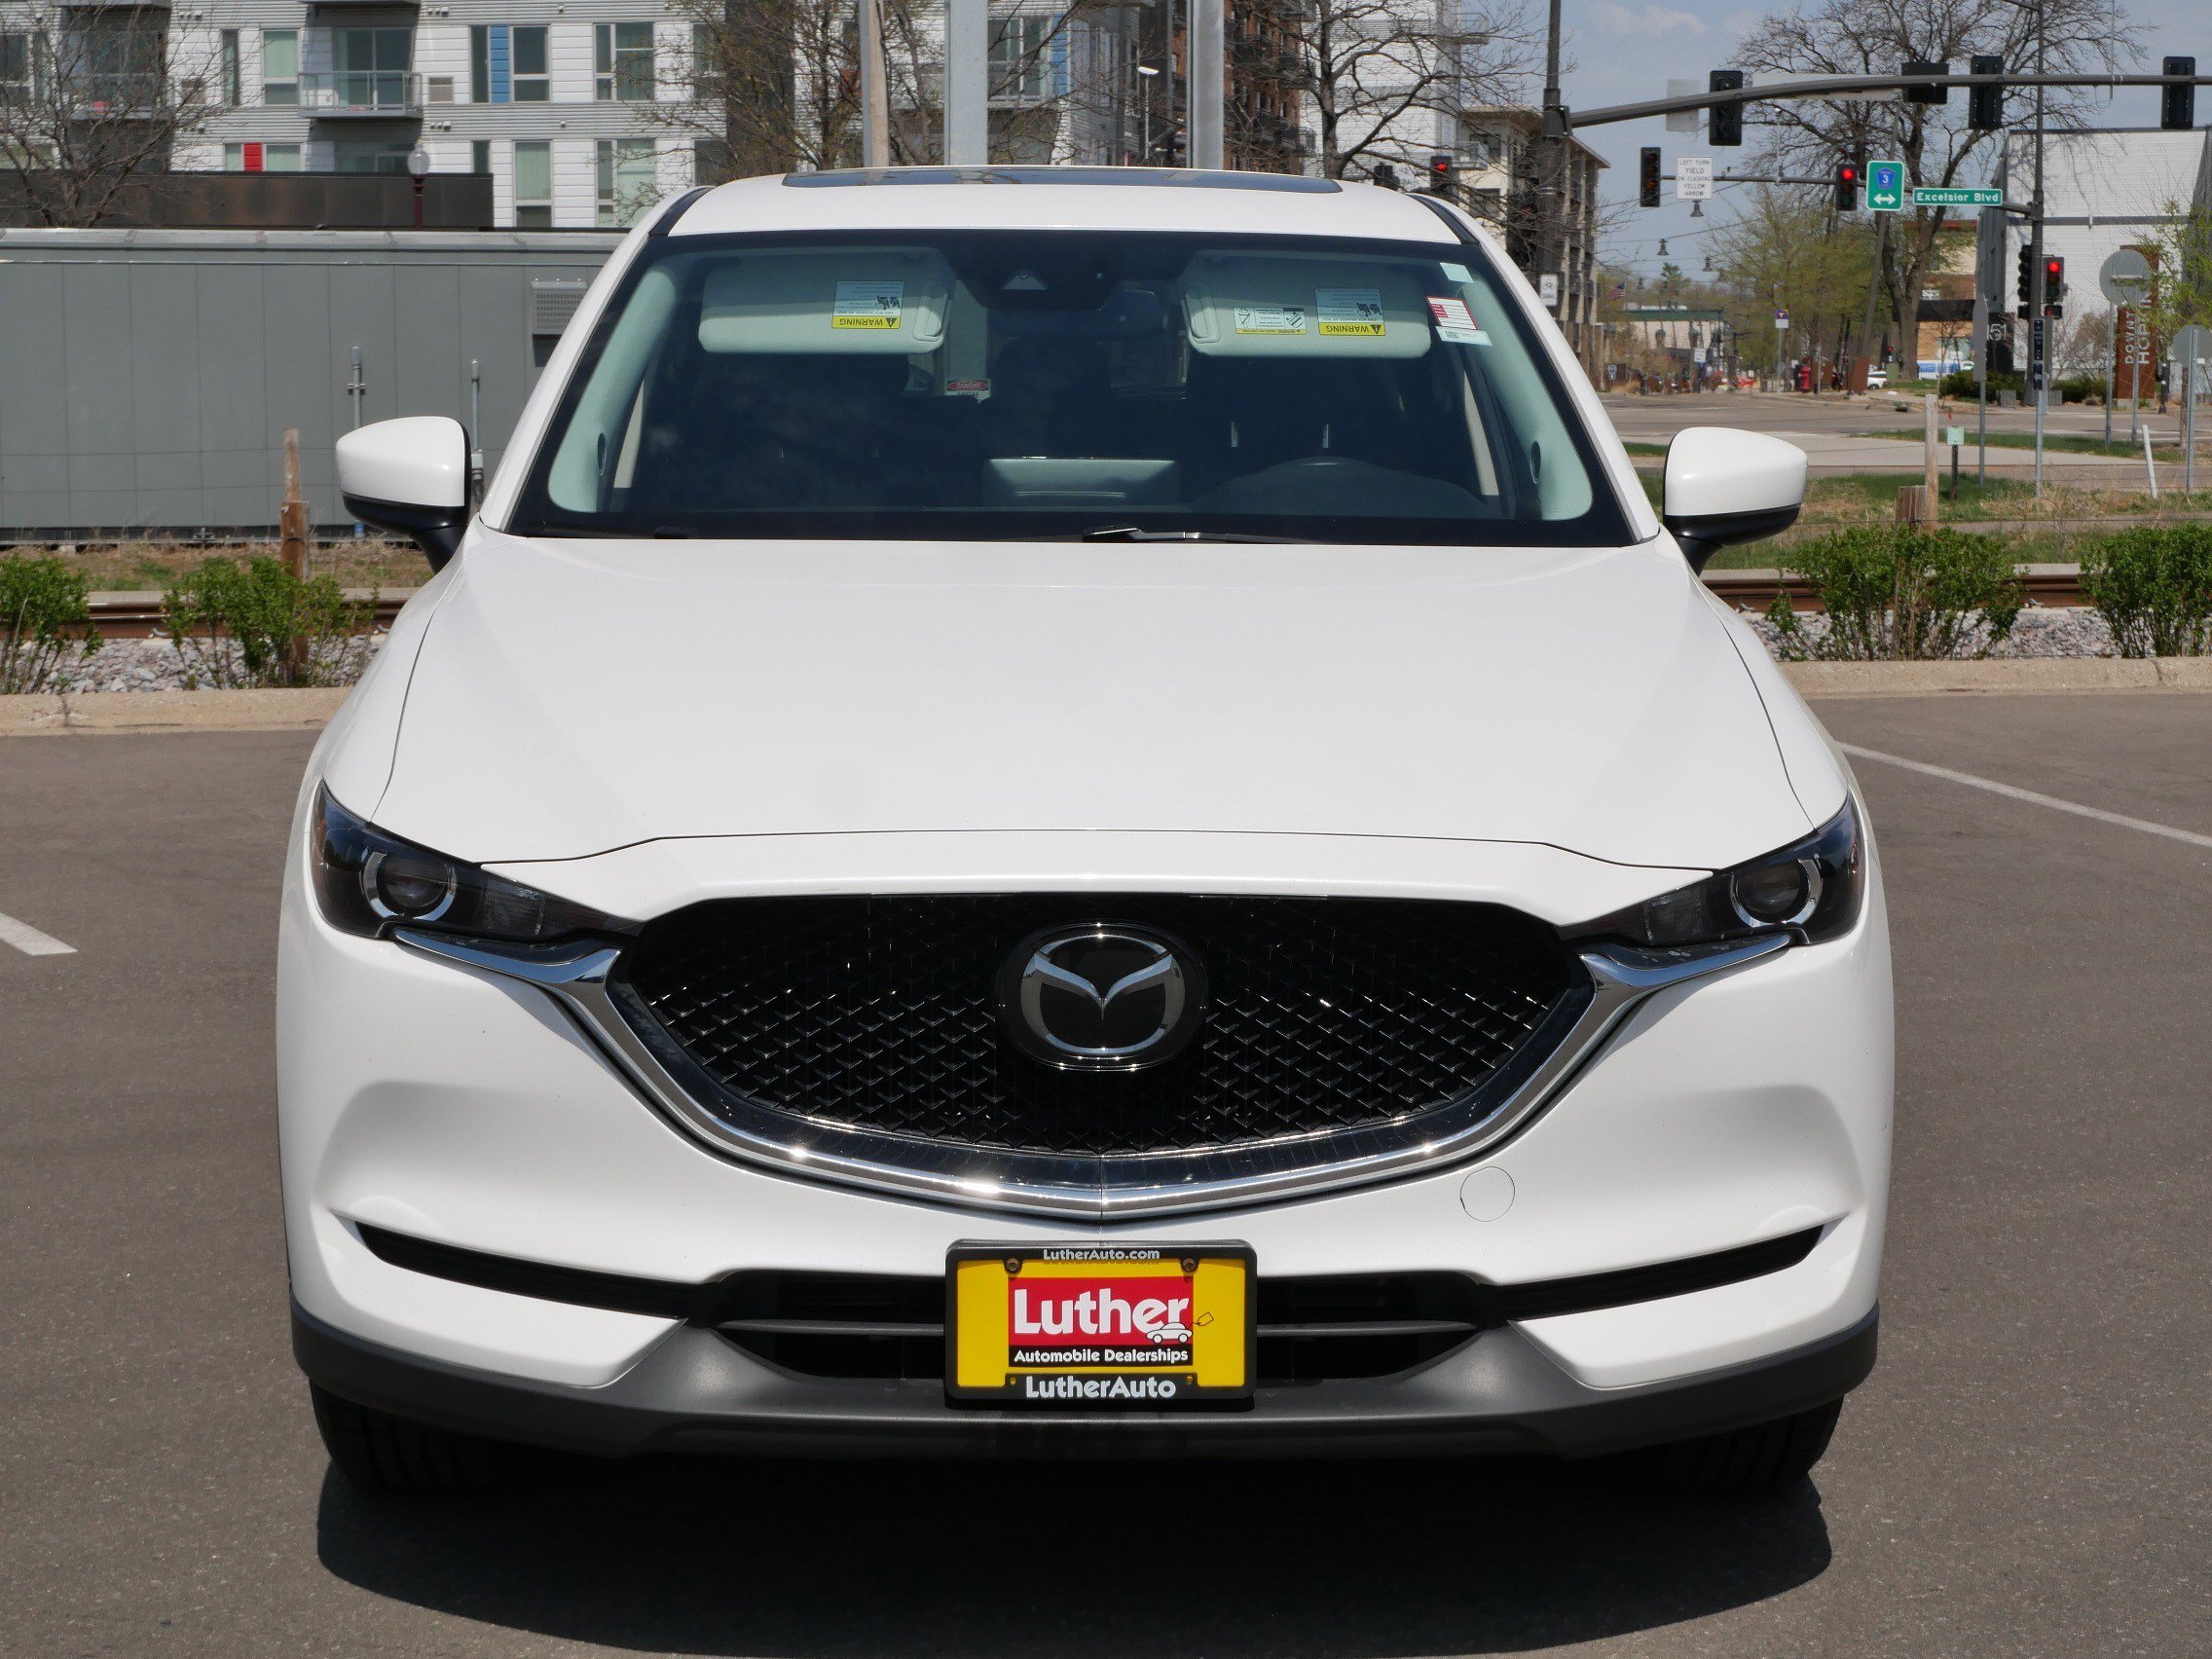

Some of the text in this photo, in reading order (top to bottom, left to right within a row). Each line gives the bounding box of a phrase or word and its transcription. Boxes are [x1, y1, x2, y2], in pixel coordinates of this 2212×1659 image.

[1882, 174, 1890, 184] 3
[1916, 192, 1999, 203] Excelsior Blvd
[839, 317, 884, 327] WARNING
[1326, 324, 1370, 333] WARNING
[1043, 1248, 1161, 1262] LutherAuto.com
[1014, 1287, 1191, 1336] Luther
[1014, 1347, 1189, 1364] Automobile Dealerships
[1025, 1375, 1177, 1399] LutherAuto
